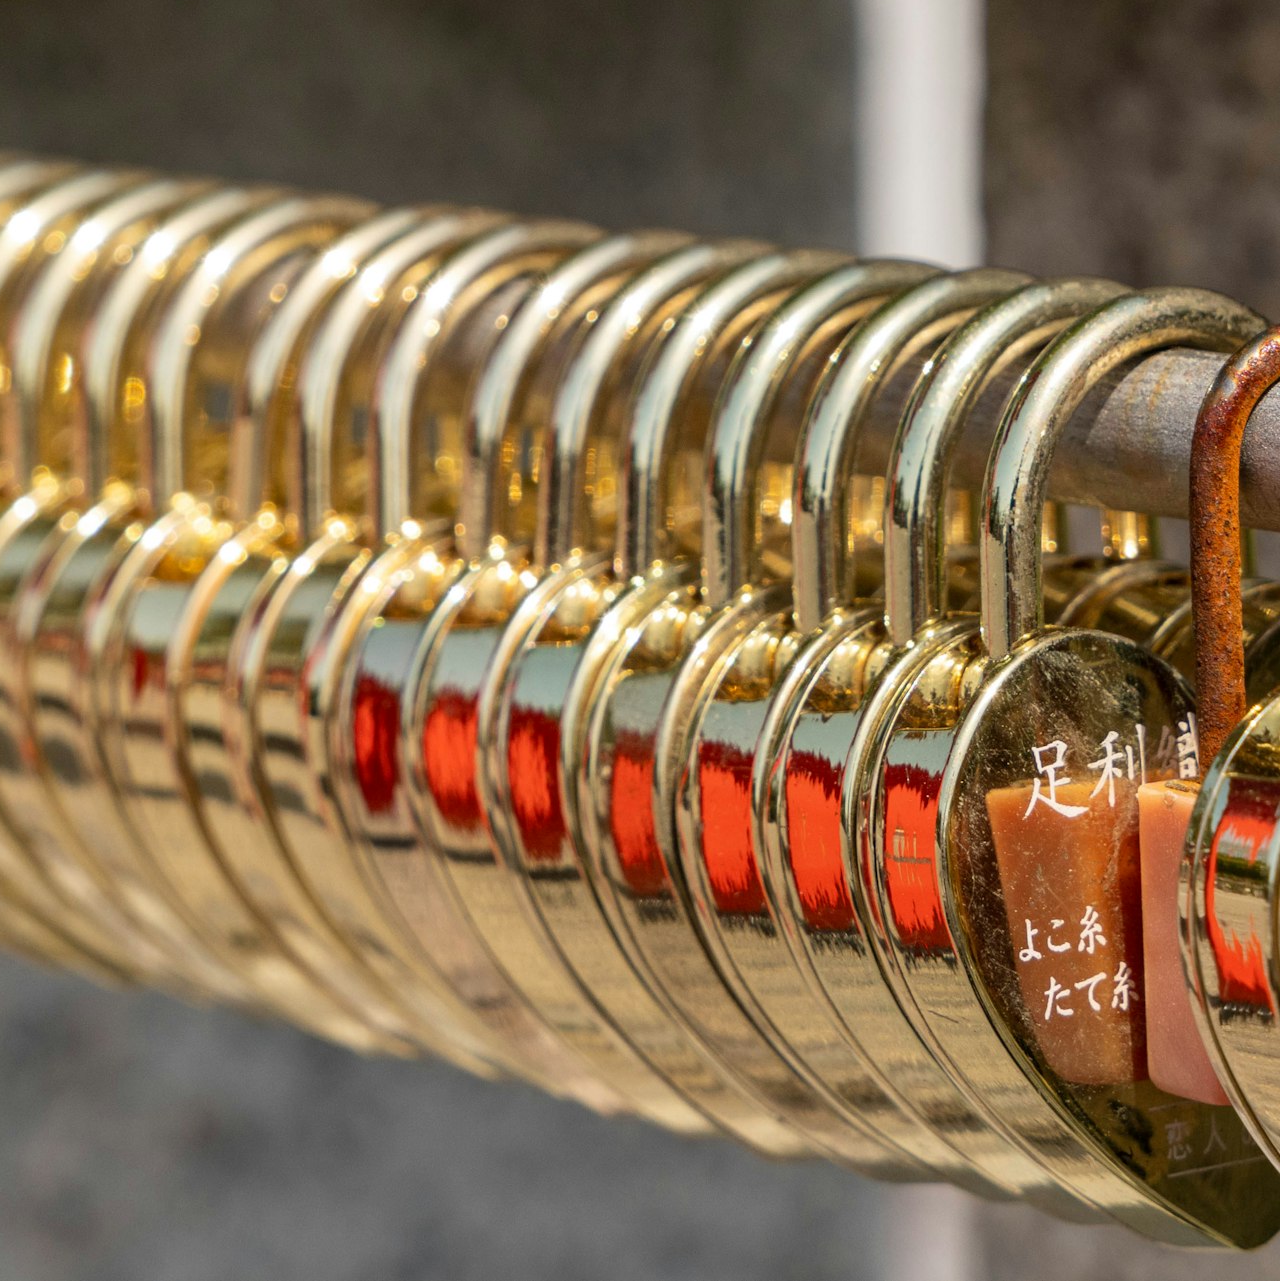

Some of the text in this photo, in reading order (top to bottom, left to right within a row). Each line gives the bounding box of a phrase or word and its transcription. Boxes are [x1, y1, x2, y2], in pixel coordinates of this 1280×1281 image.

[1019, 905, 1108, 962] よこ糸
[1044, 961, 1140, 1021] たて糸
